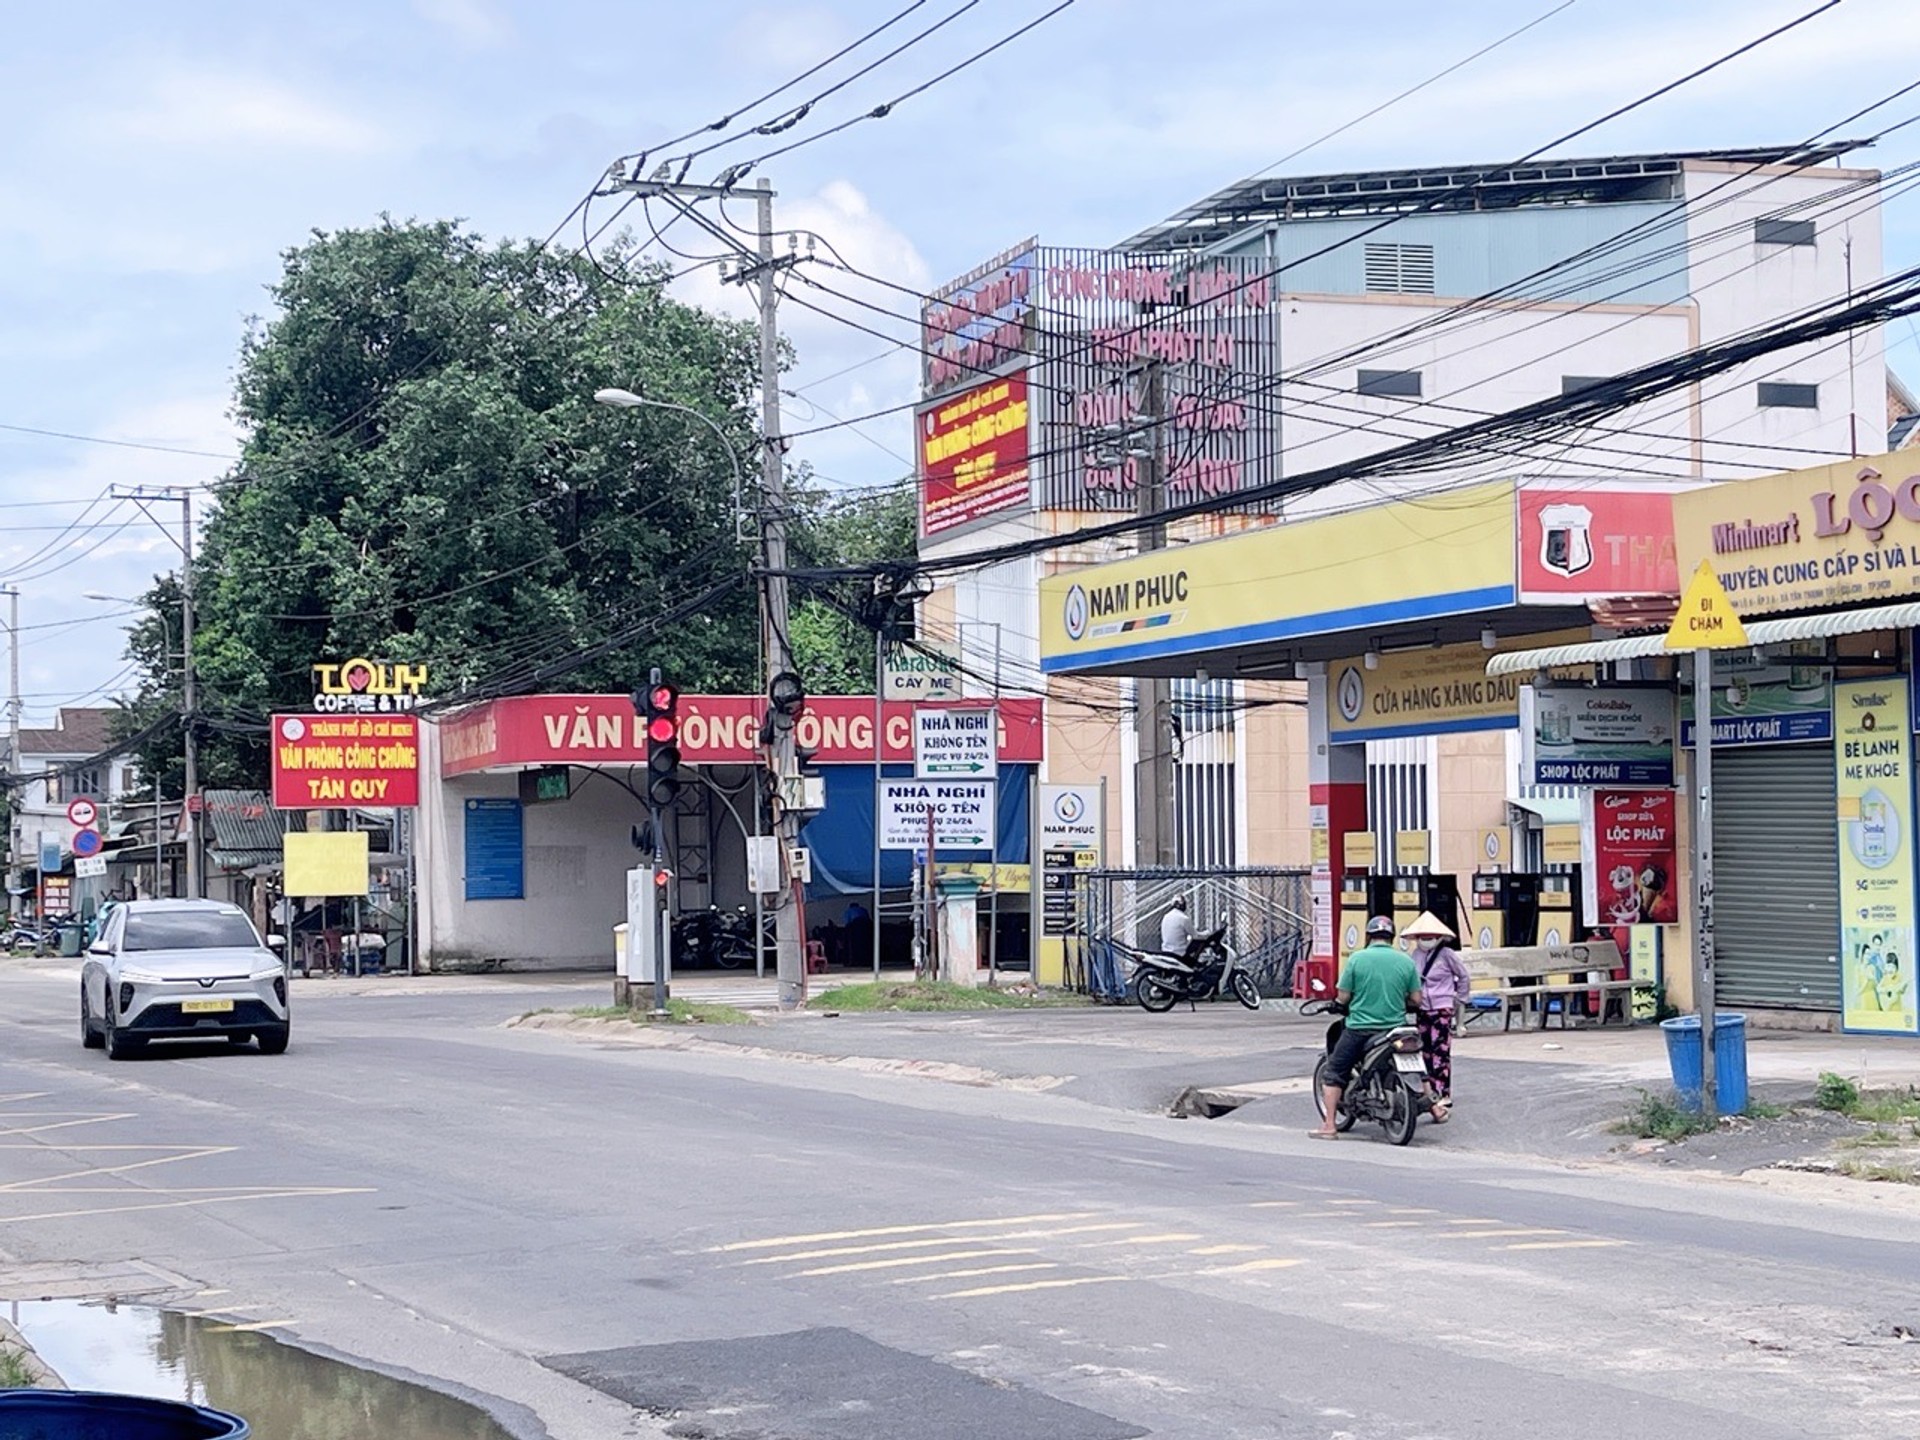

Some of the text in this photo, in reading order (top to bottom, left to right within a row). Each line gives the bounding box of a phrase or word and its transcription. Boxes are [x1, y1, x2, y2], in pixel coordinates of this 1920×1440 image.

[1048, 260, 1101, 301] CÔNG
[1148, 324, 1197, 364] PHÁT
[1716, 565, 1768, 592] HUYÊN
[1773, 560, 1819, 585] CUNG
[1824, 549, 1858, 577] CẤP
[1884, 543, 1906, 568] VÀ
[1090, 570, 1188, 618] NAM PHUC
[1701, 598, 1712, 611] ĐI
[1690, 614, 1723, 633] CHẬM
[1373, 685, 1399, 715] CỬA
[1402, 683, 1441, 712] HÀNG
[1443, 680, 1482, 706] XĂNG
[543, 705, 623, 749] VĂN
[633, 705, 760, 749] PÒNG
[795, 708, 874, 749] ÔNG
[1737, 719, 1755, 743] LỘC
[1756, 717, 1782, 738] PHÁT
[924, 733, 988, 748] KHÔNG TÊN
[1863, 740, 1899, 756] LANH
[280, 742, 302, 769] VĂN
[305, 741, 343, 769] PHÒNG
[345, 742, 376, 769] CÔNG
[378, 742, 416, 769] CHỨNG
[1541, 765, 1570, 778] SHOP
[1571, 763, 1591, 782] LỘC
[1593, 764, 1620, 778] PHÁT
[308, 776, 388, 799] TÂN QUY
[888, 784, 986, 798] NHÀ NGHỈ
[952, 801, 980, 813] TÊN
[1606, 825, 1666, 844] LỘC PHÁT
[1046, 854, 1067, 862] FUEL
